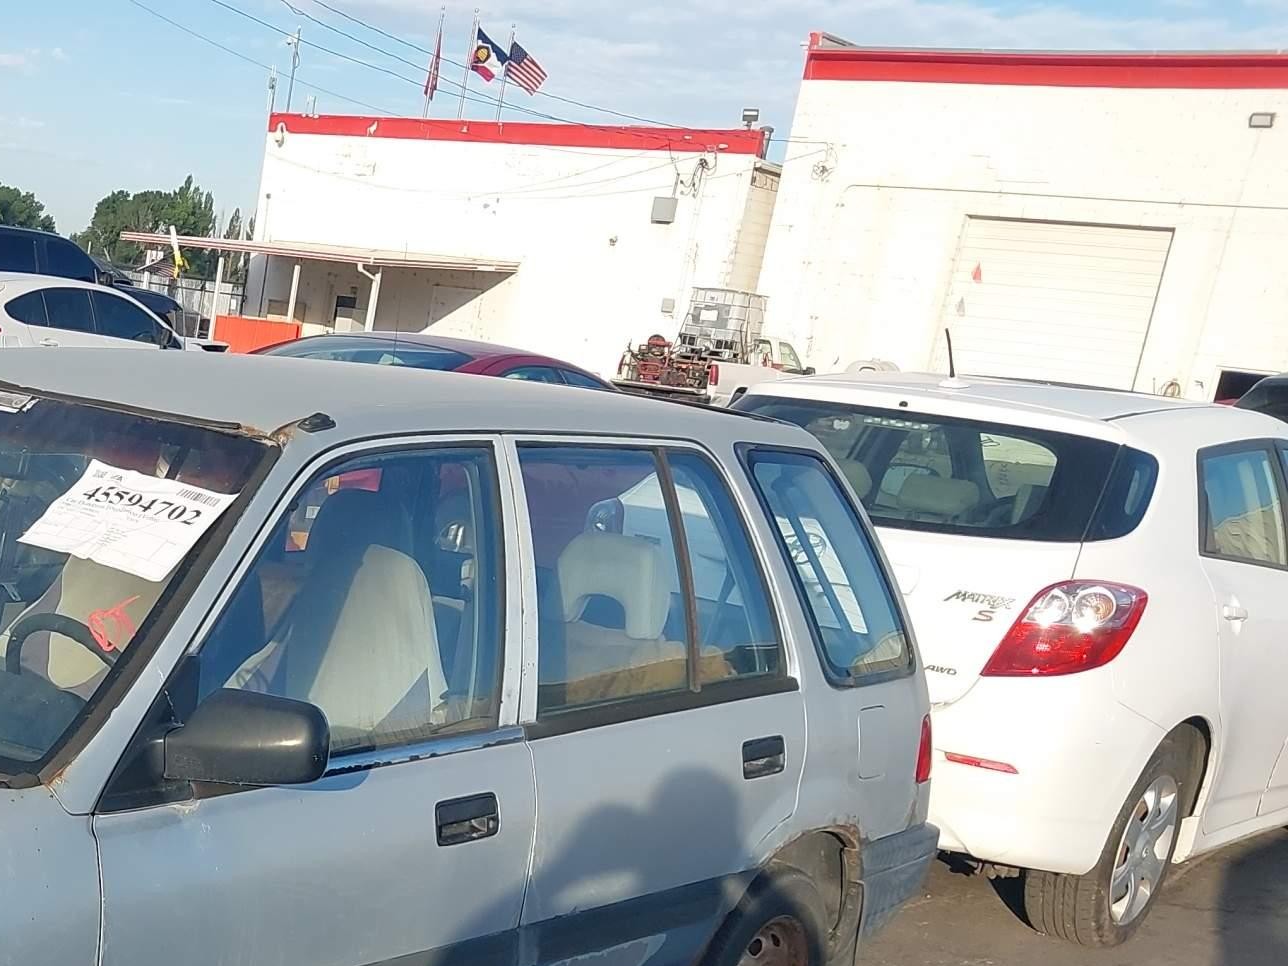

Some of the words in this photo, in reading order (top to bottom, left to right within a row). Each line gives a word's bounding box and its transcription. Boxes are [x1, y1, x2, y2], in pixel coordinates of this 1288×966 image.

[83, 486, 202, 525] 45594702
[972, 610, 996, 622] S
[923, 664, 958, 676] AWD
